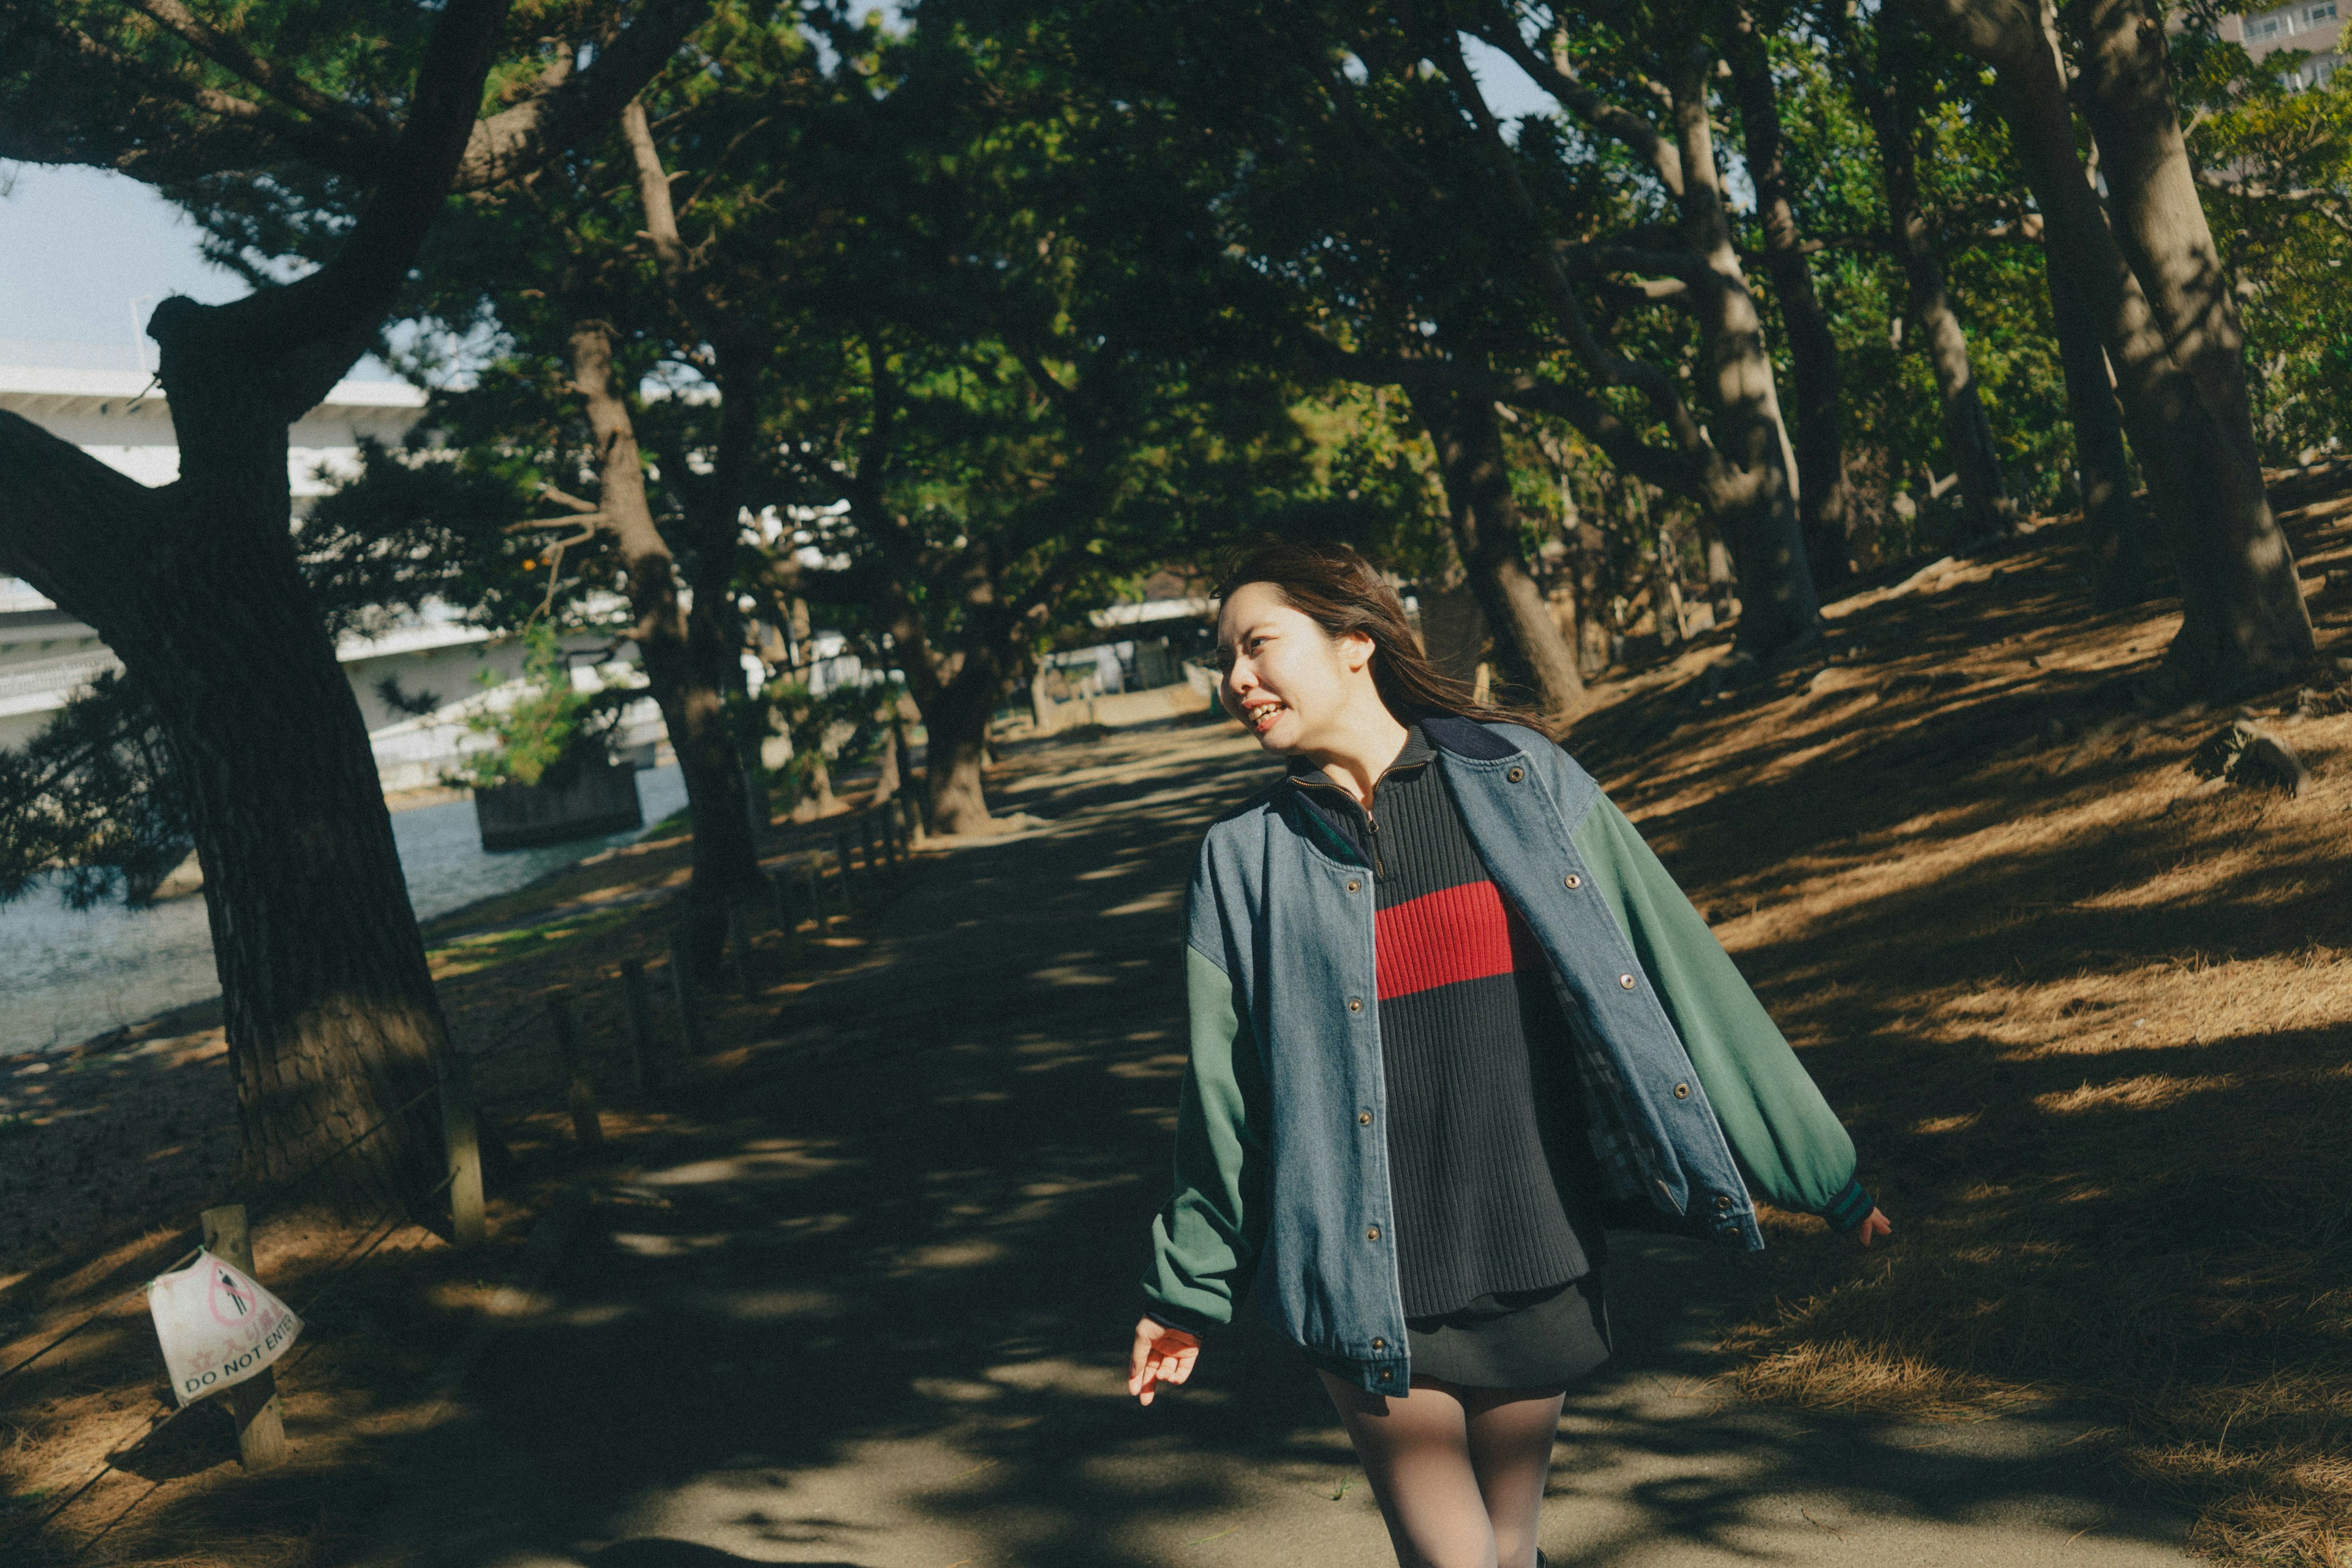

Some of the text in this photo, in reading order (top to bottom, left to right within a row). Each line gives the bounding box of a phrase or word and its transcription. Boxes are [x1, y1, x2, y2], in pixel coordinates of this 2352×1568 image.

[186, 1314, 293, 1393] DO NOT ENTER
